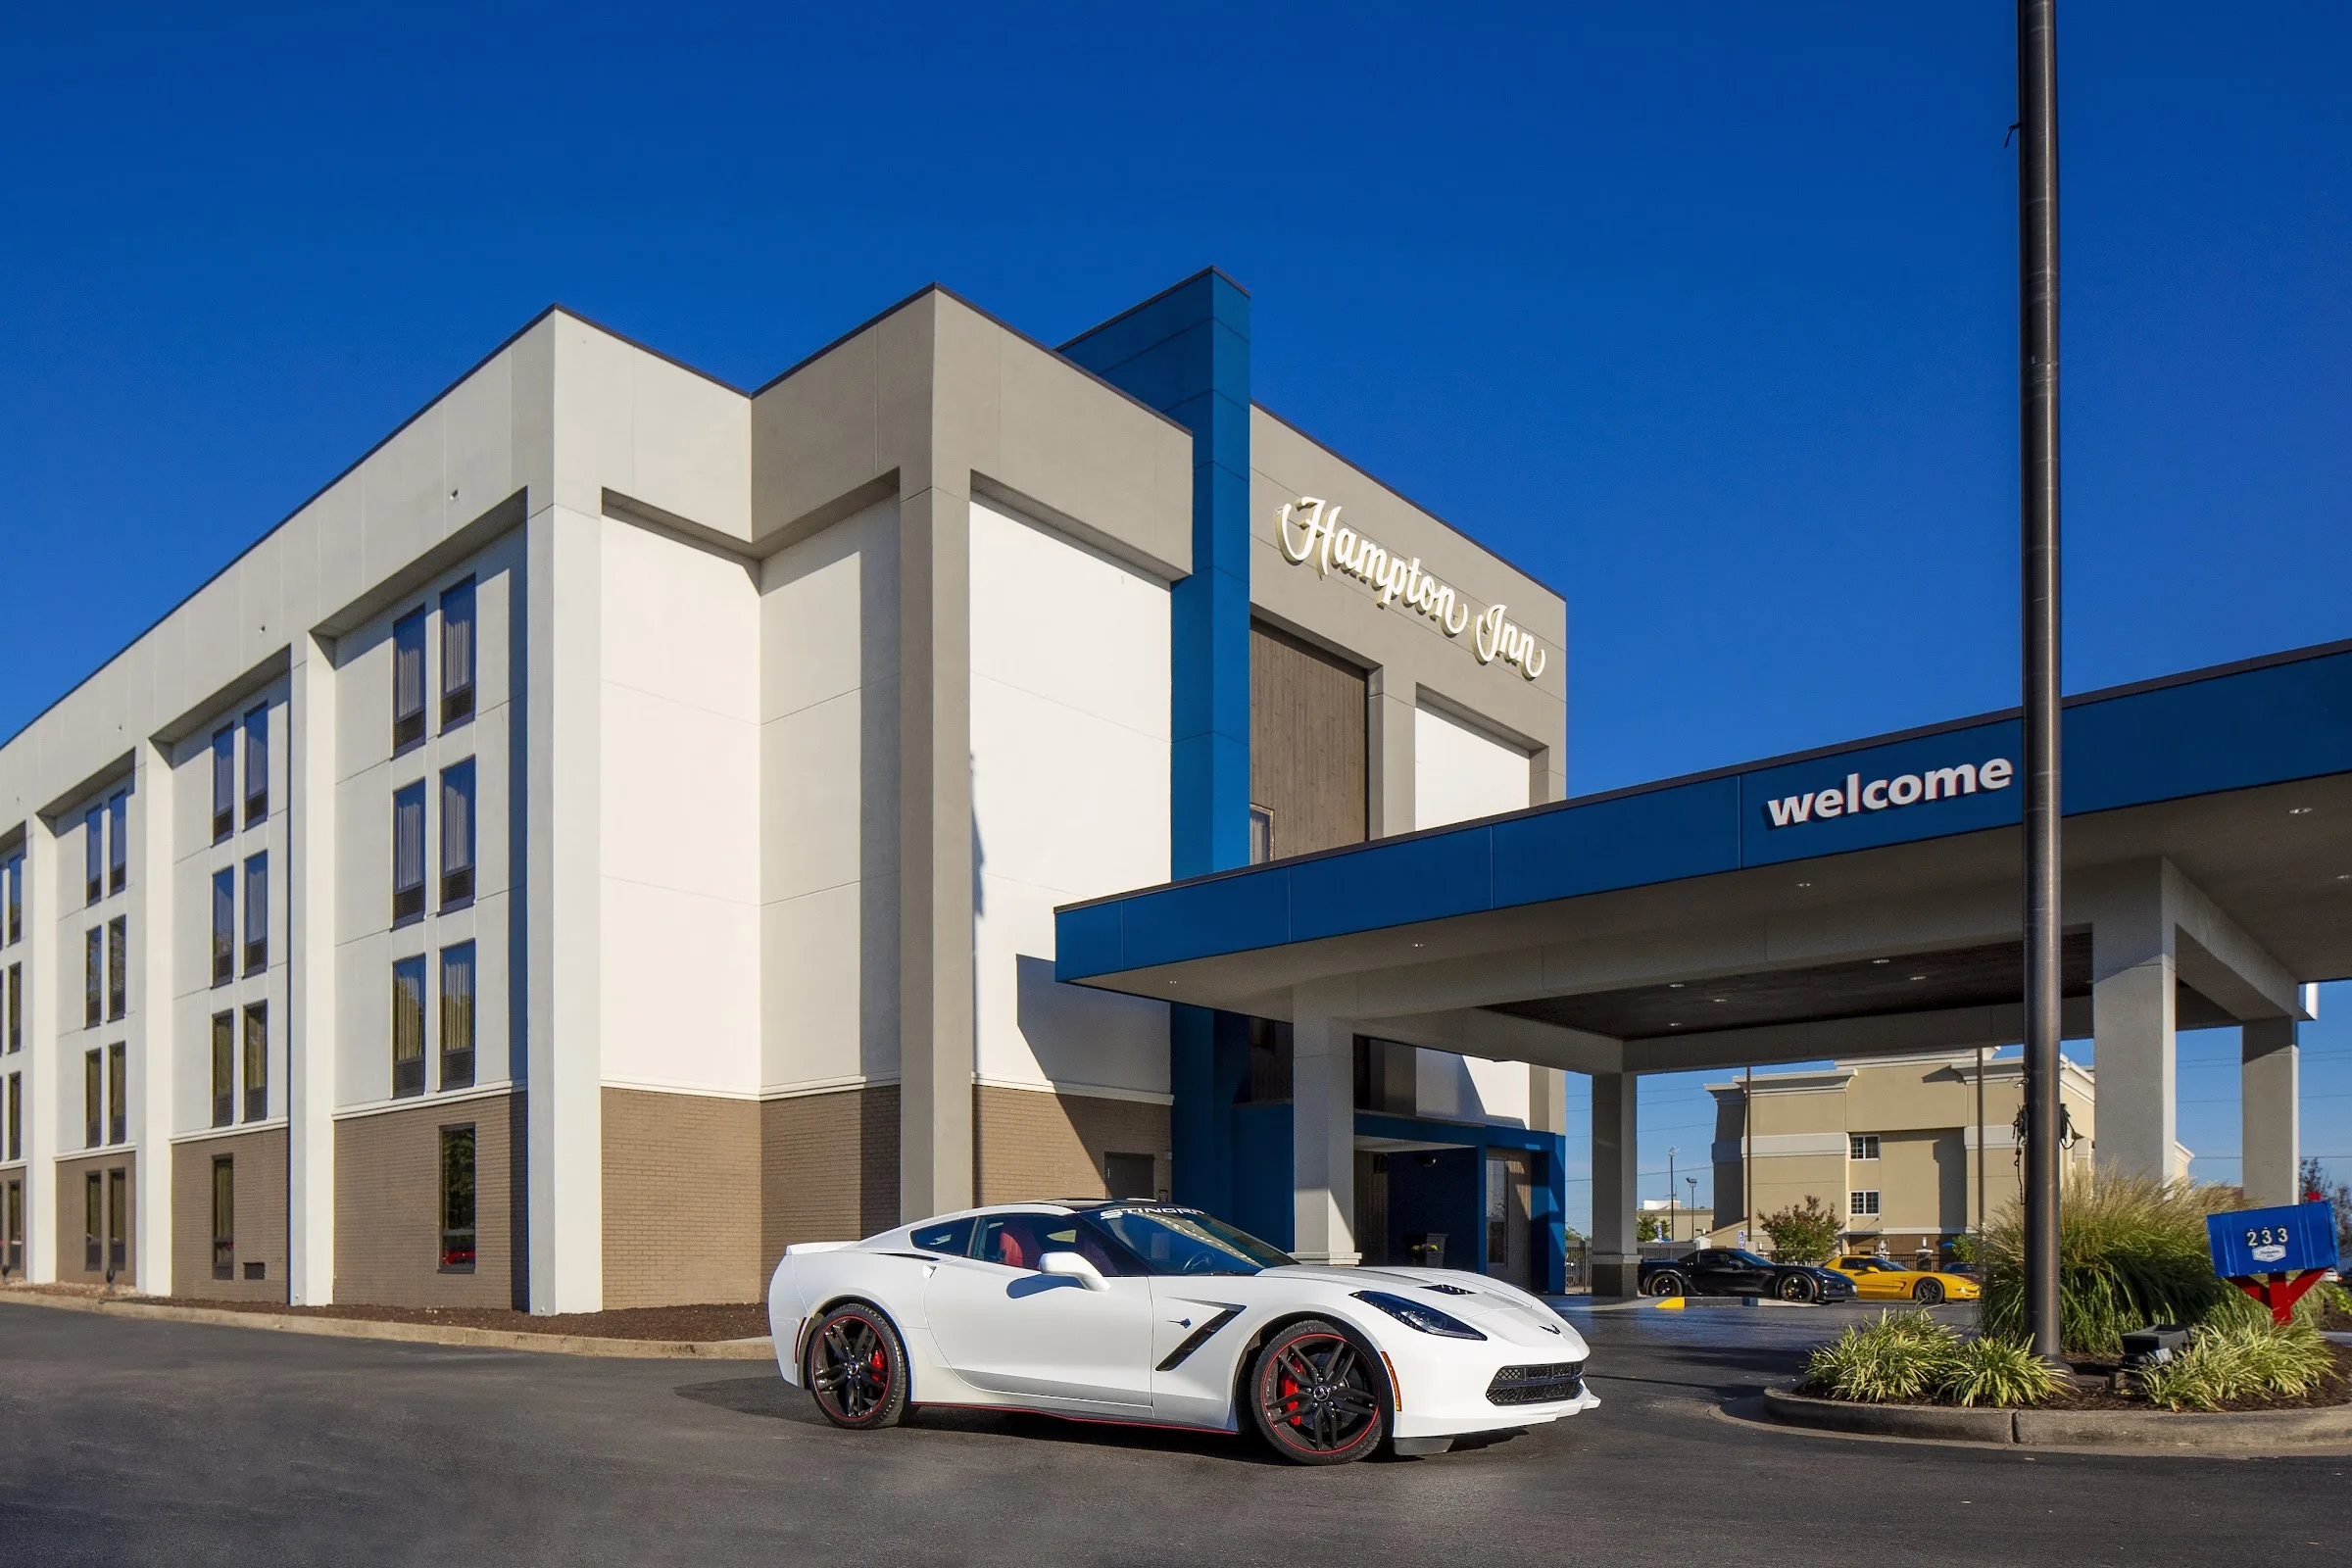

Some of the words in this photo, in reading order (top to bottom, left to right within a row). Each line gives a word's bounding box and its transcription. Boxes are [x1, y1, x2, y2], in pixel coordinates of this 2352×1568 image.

[1276, 497, 1468, 636] Hampton
[1473, 604, 1545, 678] Inn
[1767, 758, 2012, 826] welcome
[1100, 1207, 1209, 1220] STINGRA
